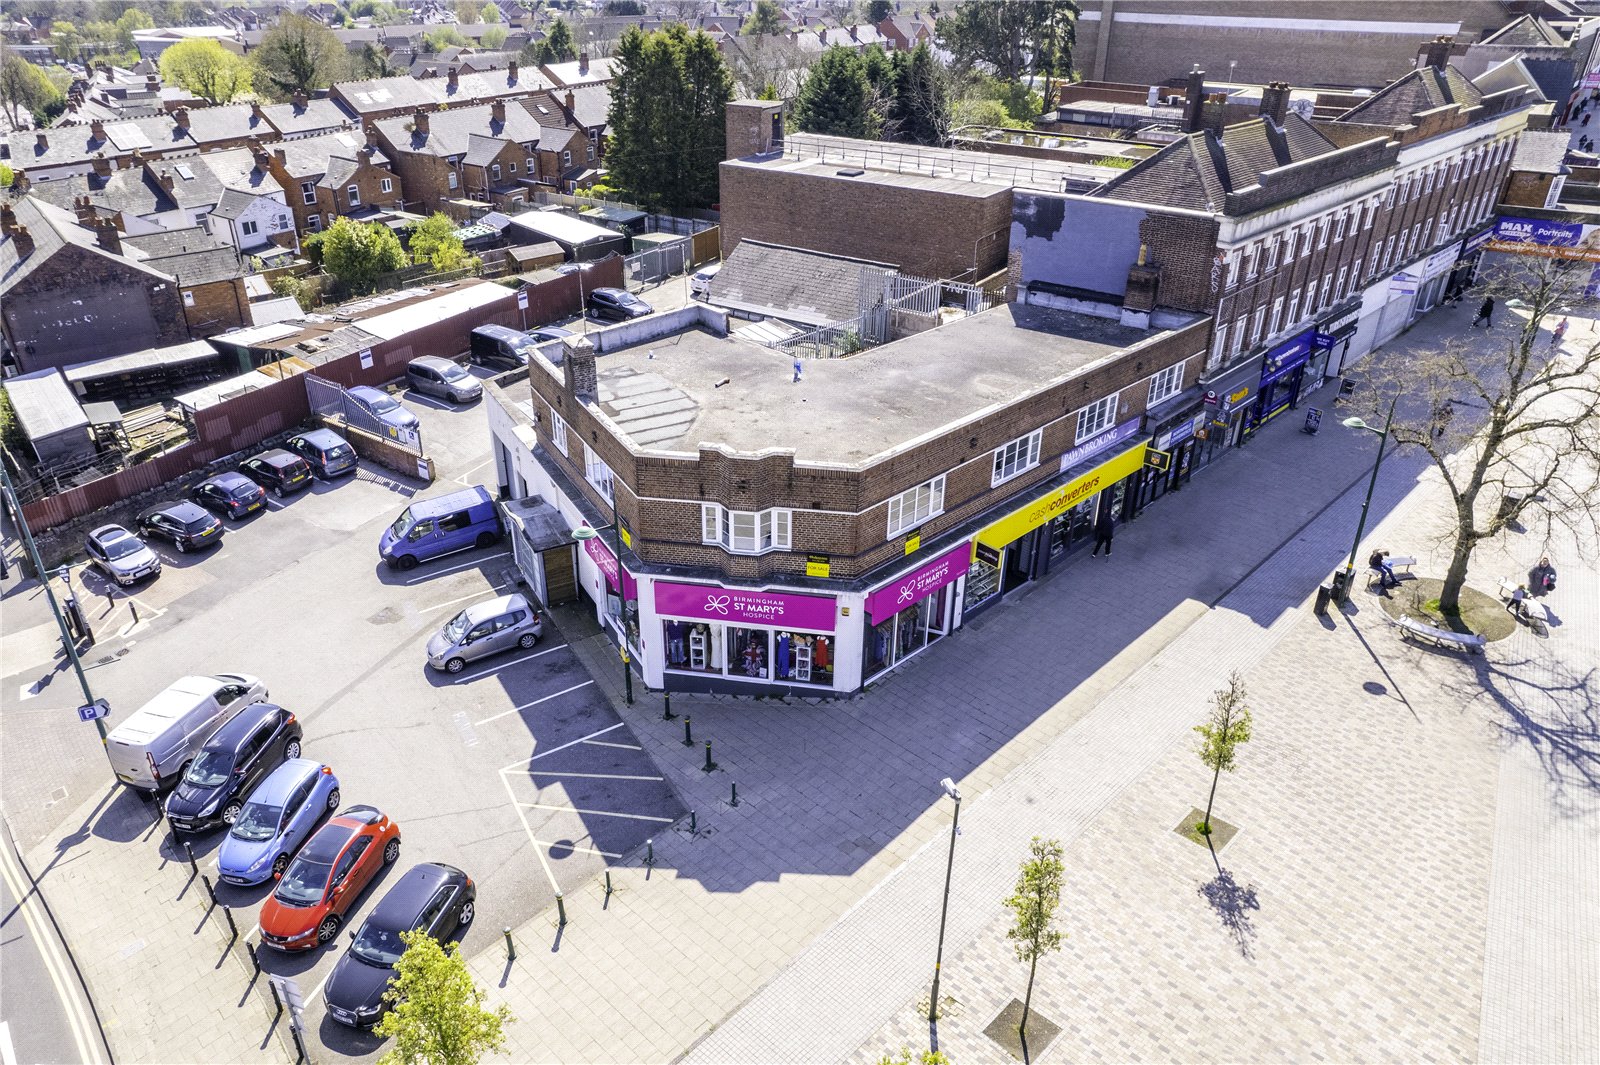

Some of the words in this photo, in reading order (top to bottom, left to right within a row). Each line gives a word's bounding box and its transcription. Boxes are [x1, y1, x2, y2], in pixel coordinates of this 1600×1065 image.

[1500, 221, 1534, 233] MAX
[1537, 228, 1574, 239] Portraits
[1064, 429, 1118, 463] PAWNBROKING
[917, 561, 949, 581] BIRMINGHAM
[917, 580, 925, 590] ST
[925, 567, 949, 586] MARY'S
[922, 578, 943, 593] HOSPICE
[733, 596, 785, 606] BIRMINGHAM
[734, 602, 746, 611] ST
[747, 604, 785, 615] MARY'S
[743, 612, 775, 620] HOSPICE
[83, 709, 94, 719] P
